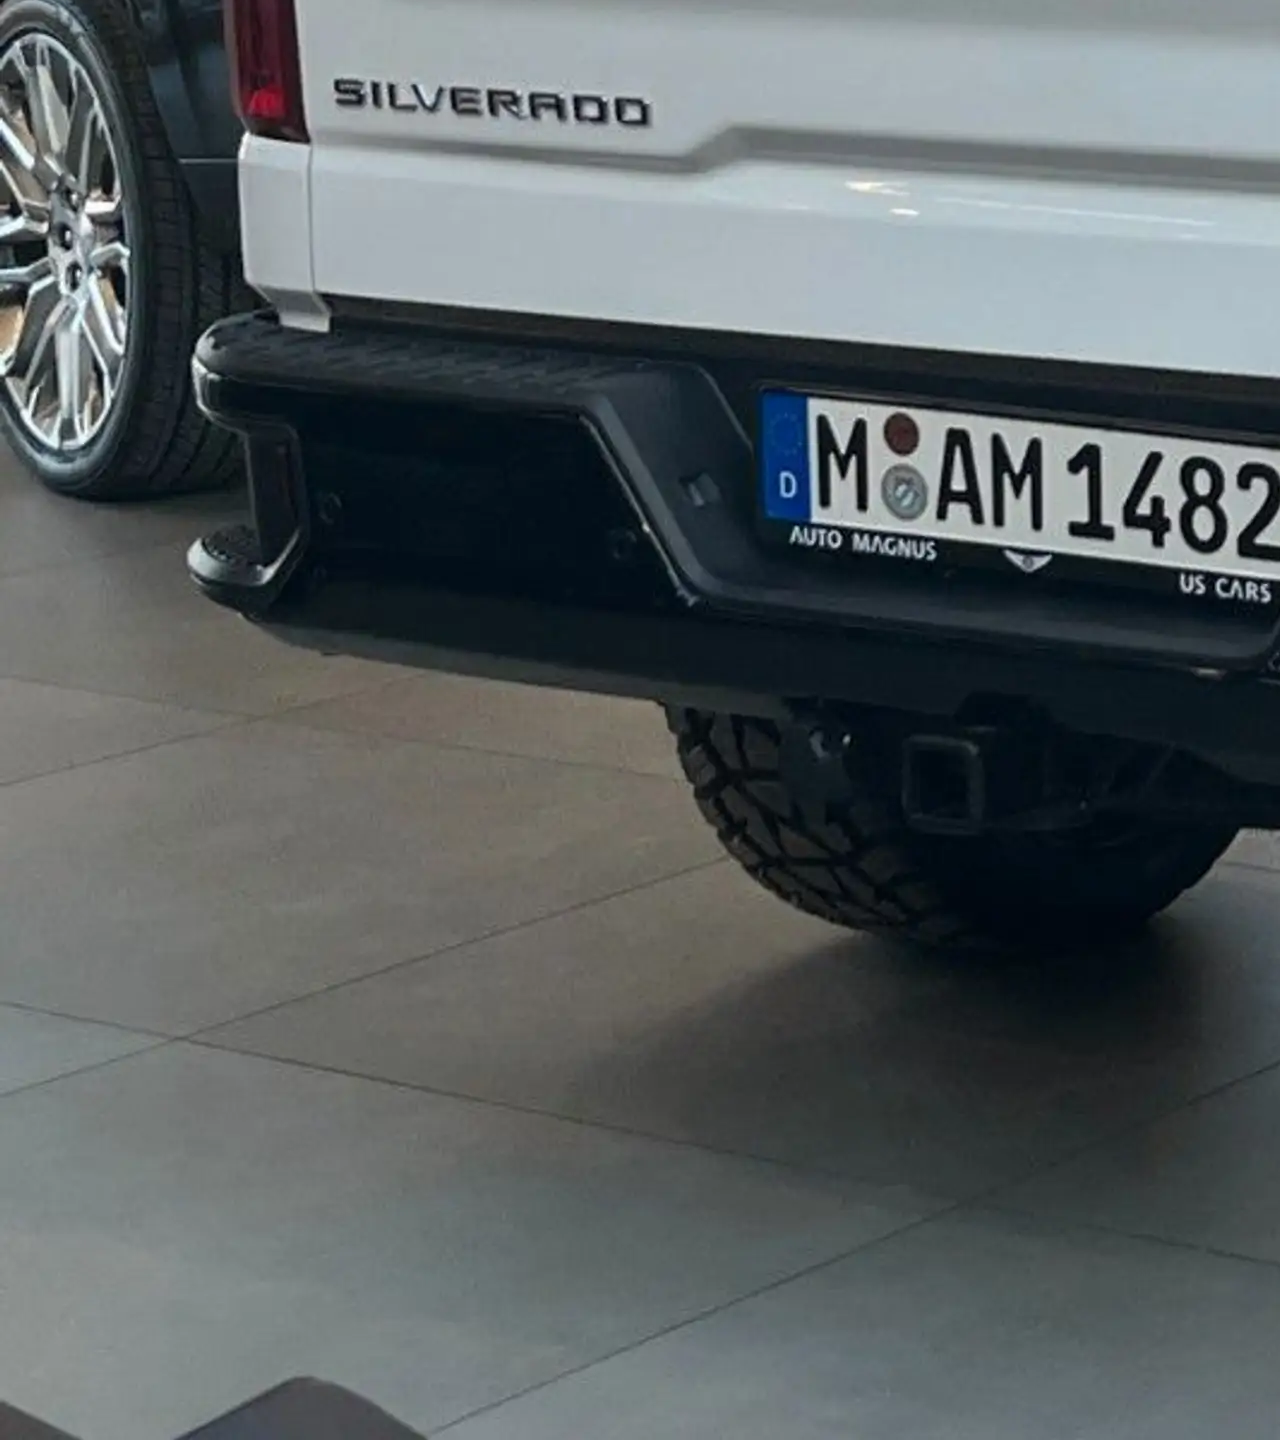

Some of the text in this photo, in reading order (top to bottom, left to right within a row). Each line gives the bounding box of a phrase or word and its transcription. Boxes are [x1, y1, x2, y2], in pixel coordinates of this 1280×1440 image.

[333, 78, 653, 127] SILVERADO
[816, 413, 868, 513] M
[779, 471, 798, 498] D
[789, 525, 938, 561] AUTO MAGNUS
[1179, 572, 1272, 603] US CARS
